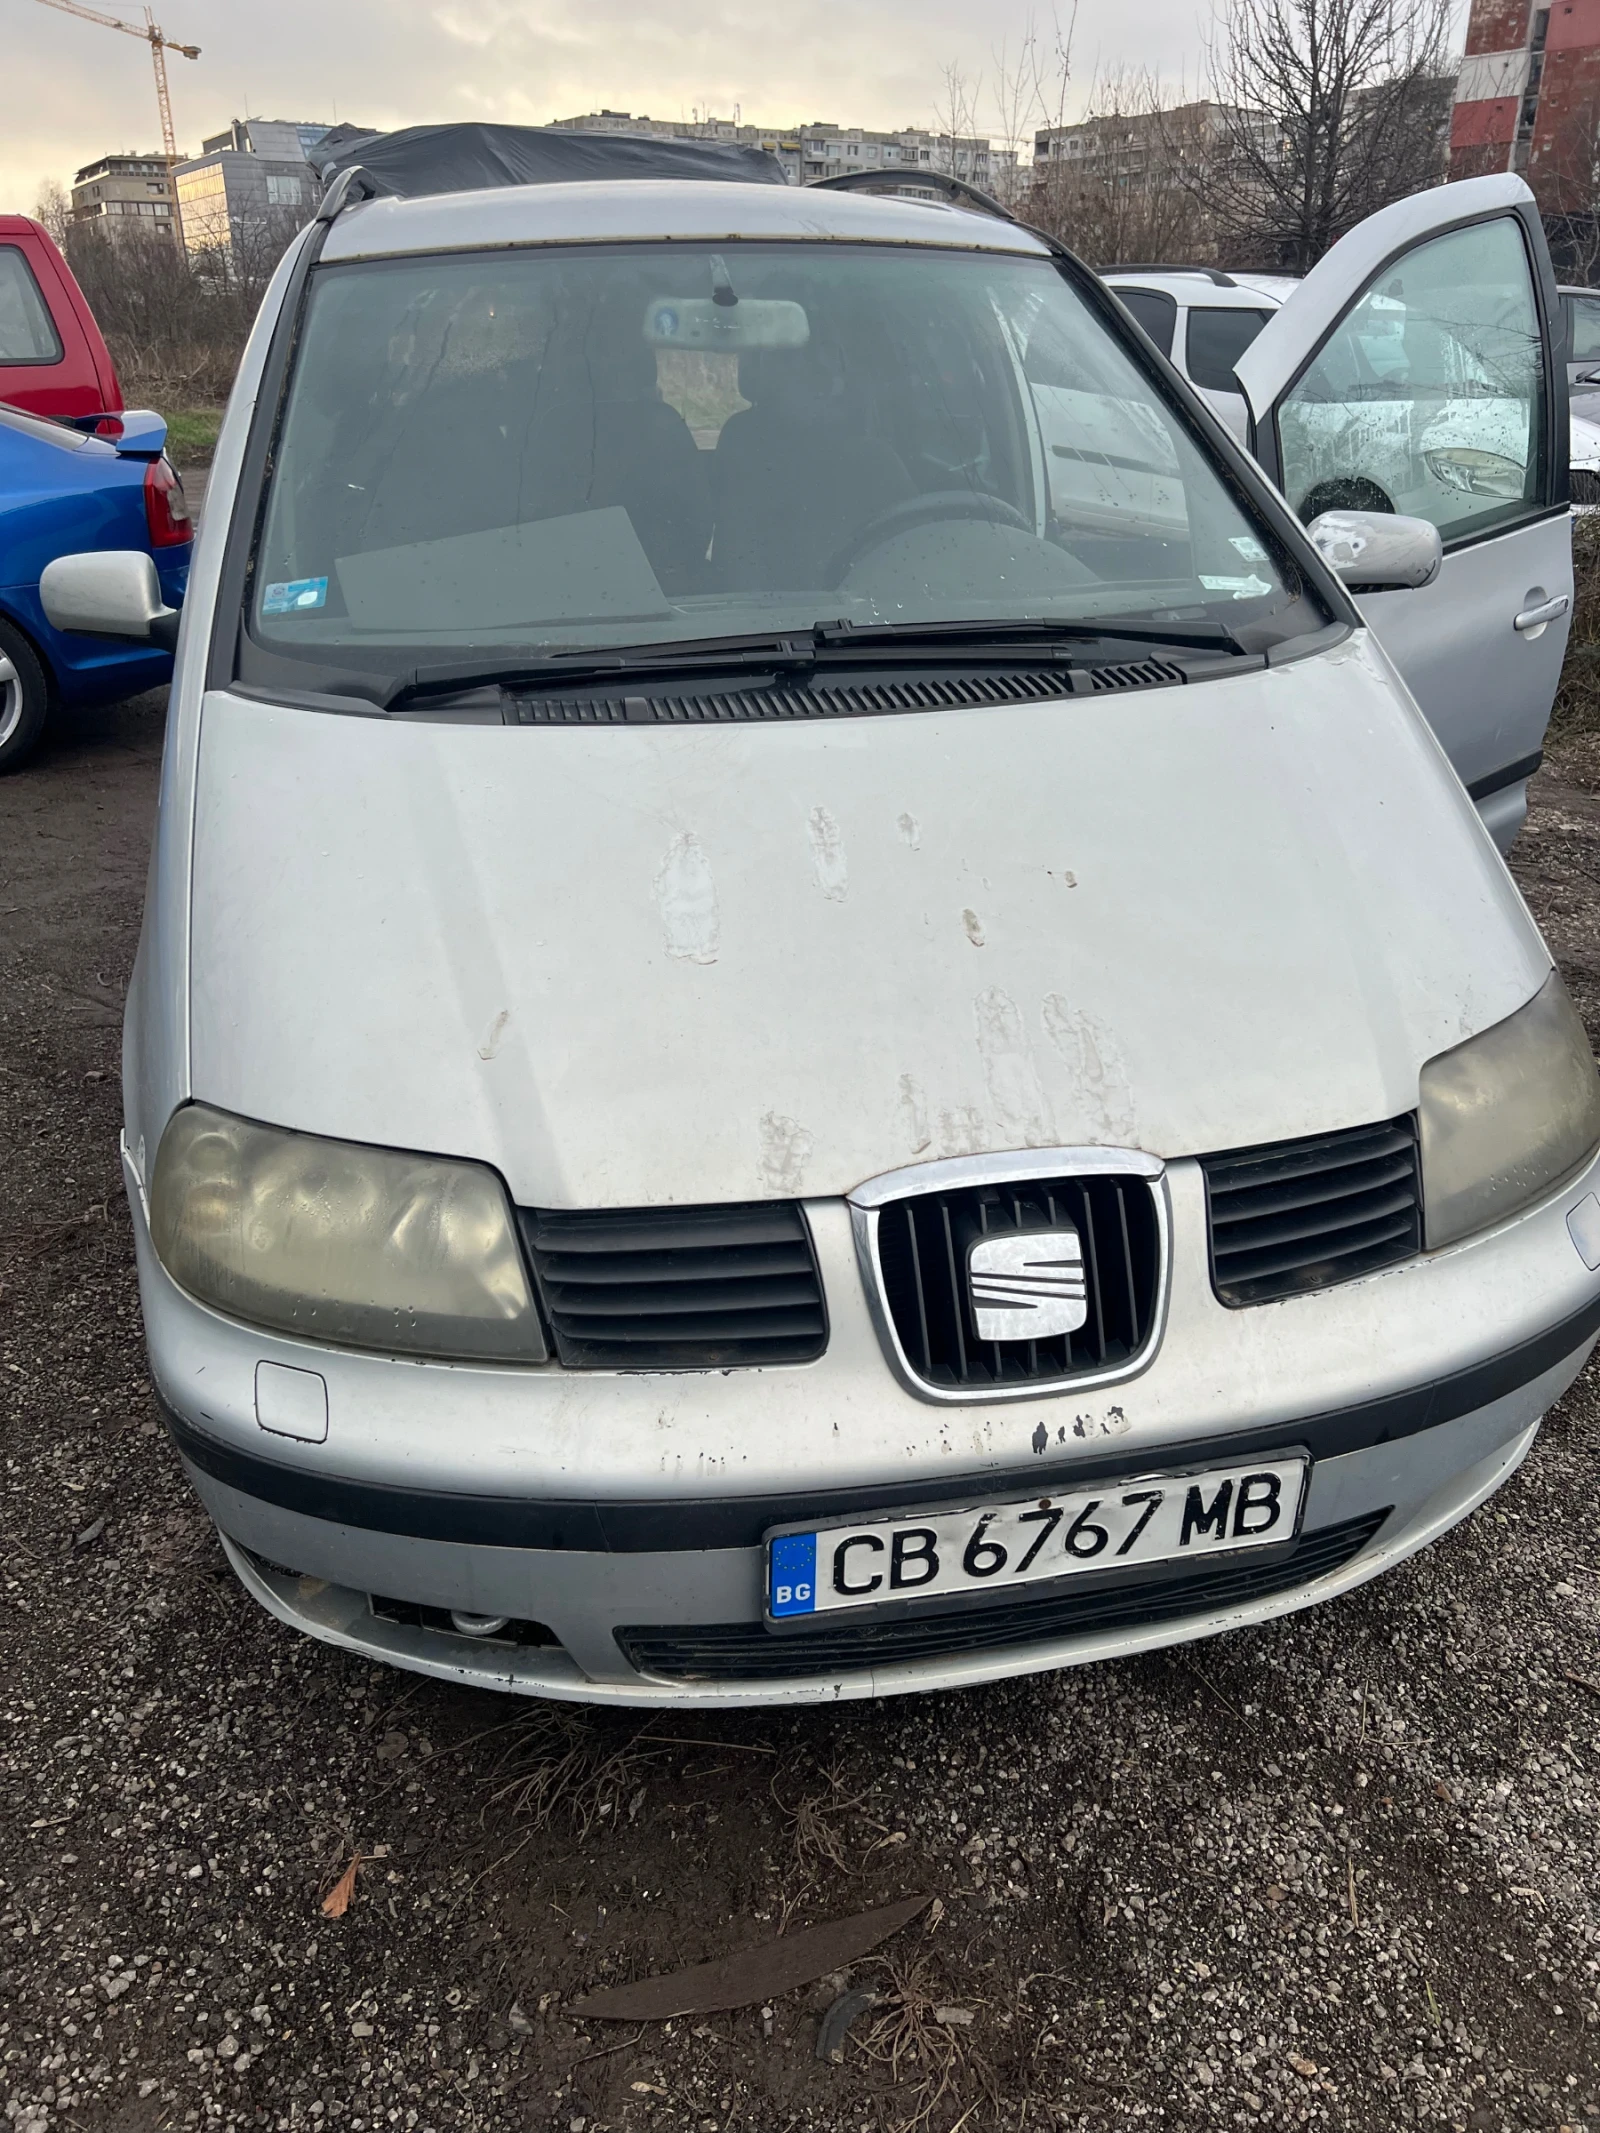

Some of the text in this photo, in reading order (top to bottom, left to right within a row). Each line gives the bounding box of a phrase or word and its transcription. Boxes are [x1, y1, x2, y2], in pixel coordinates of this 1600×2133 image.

[776, 1472, 1282, 1604] BG CB 6767 MB
